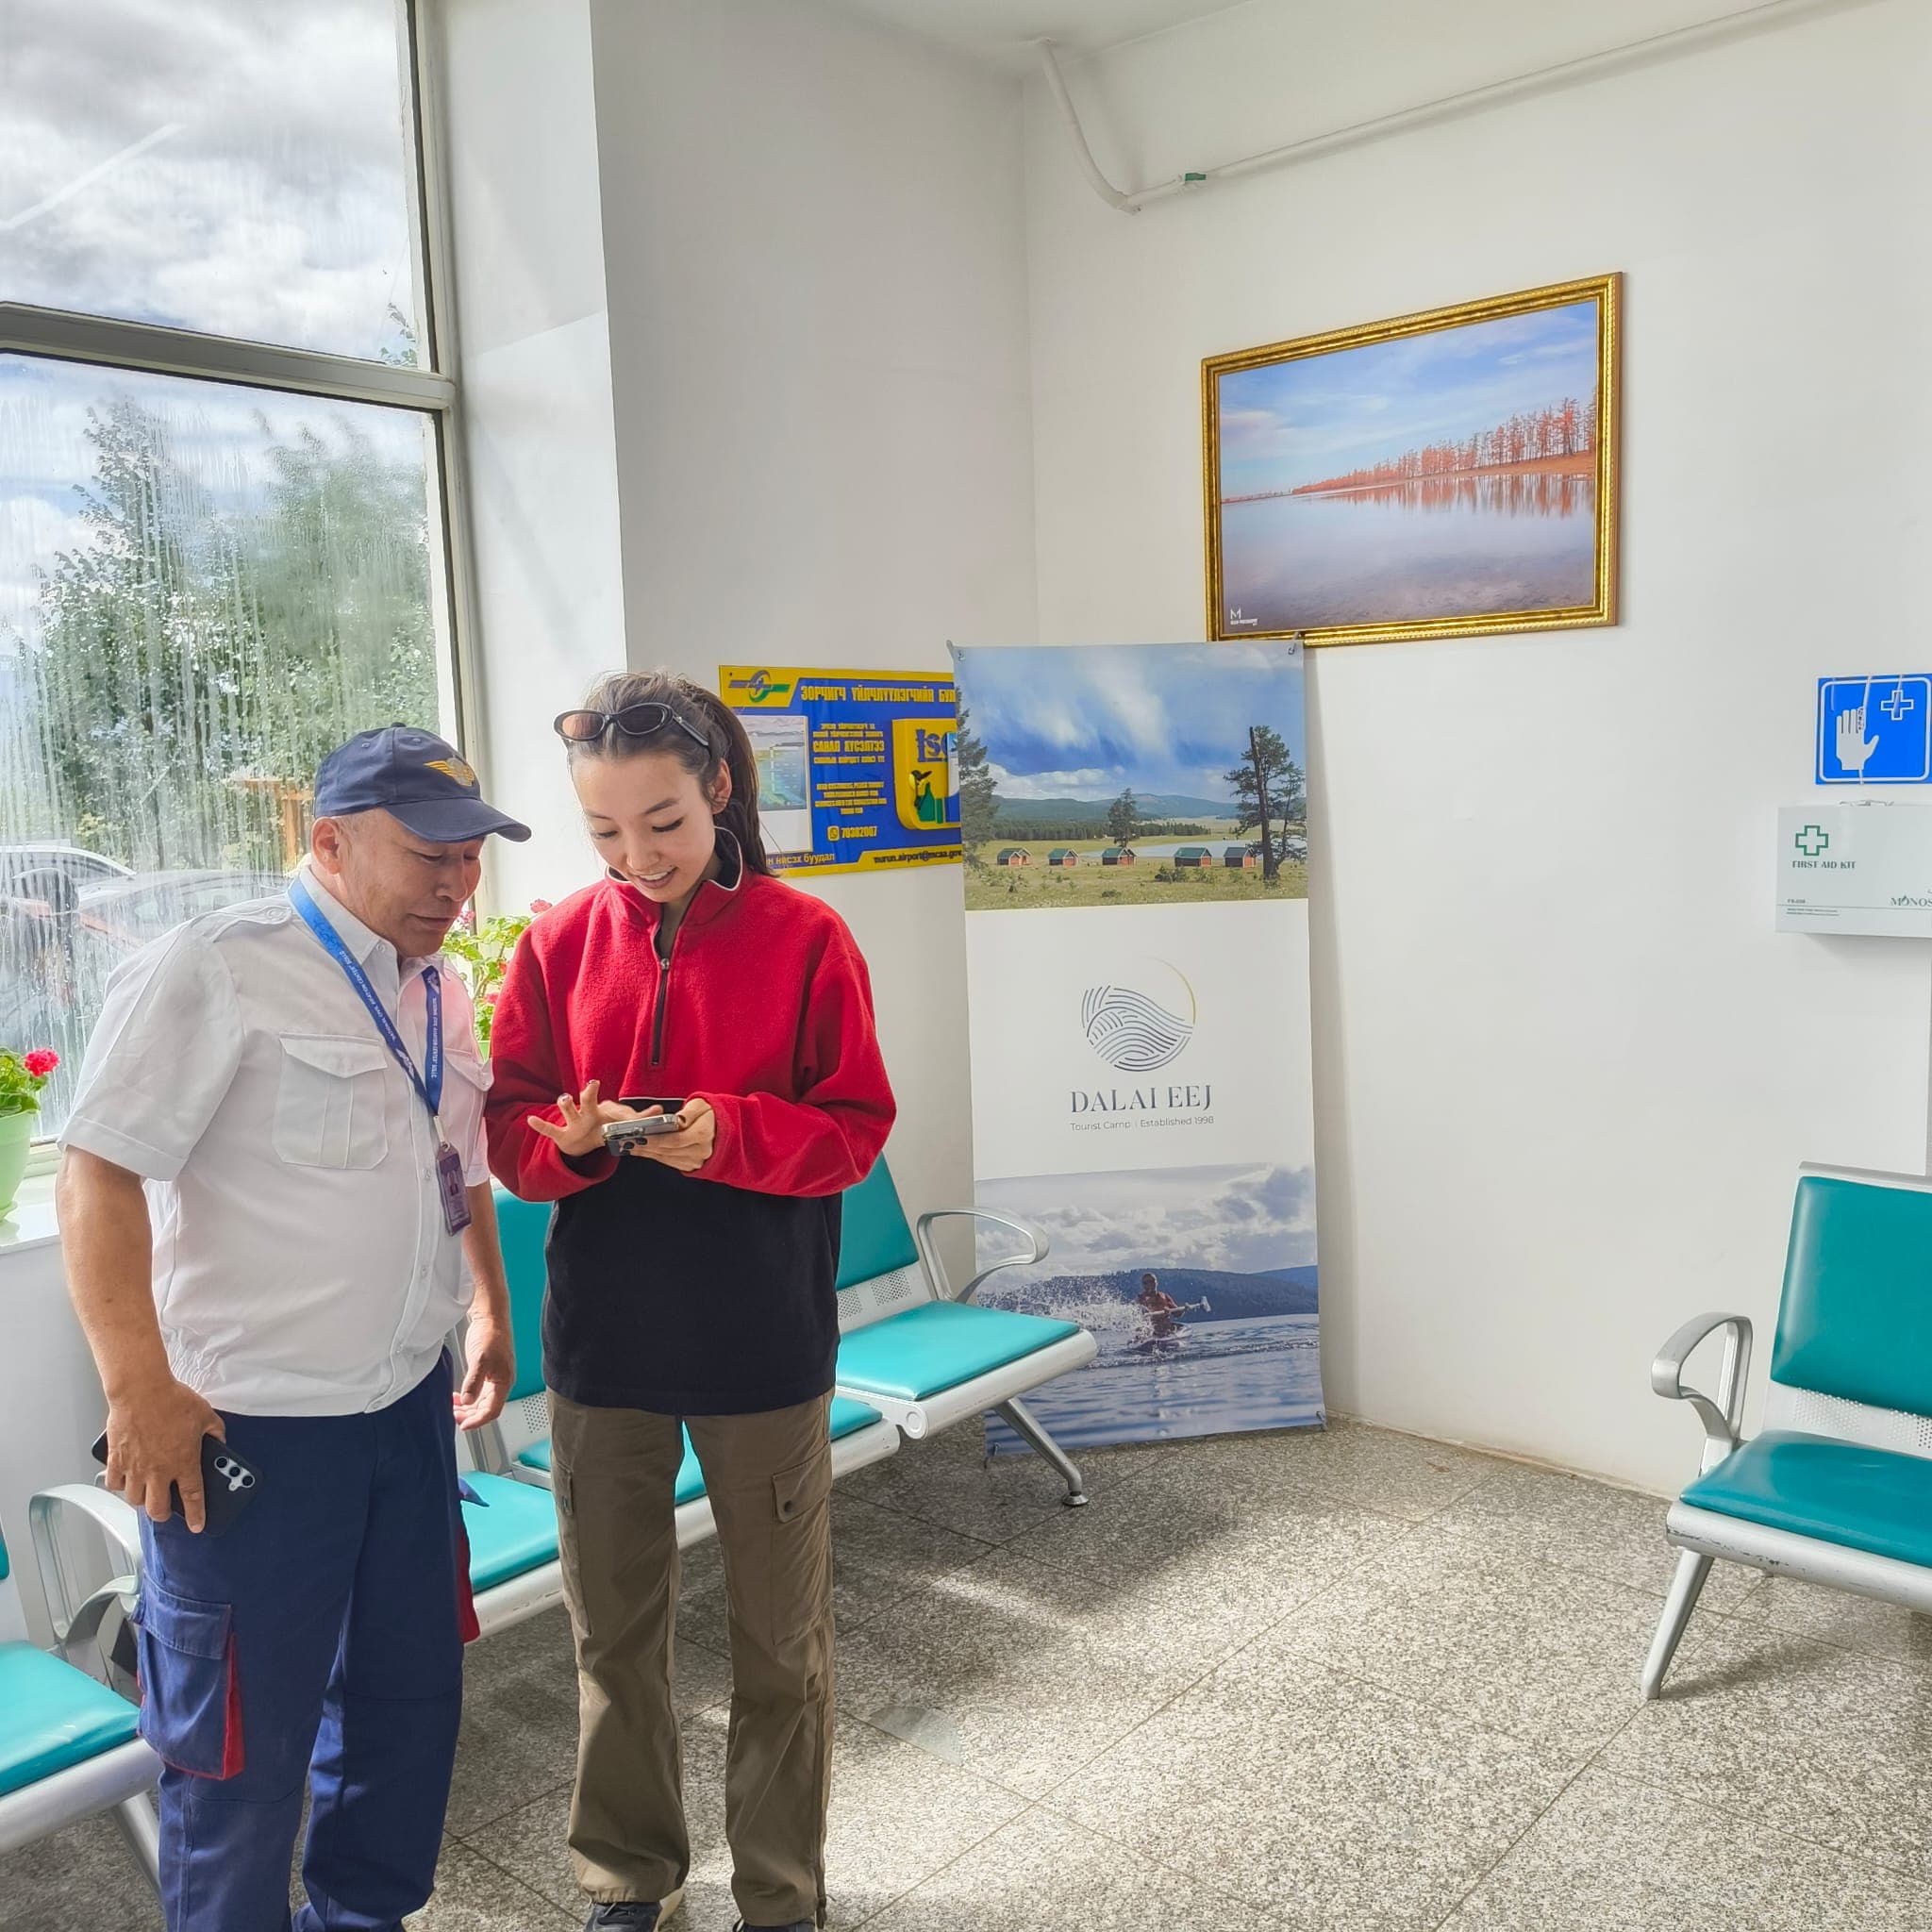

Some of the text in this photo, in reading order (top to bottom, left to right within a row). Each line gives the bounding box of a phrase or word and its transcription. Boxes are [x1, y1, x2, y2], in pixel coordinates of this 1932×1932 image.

[800, 686, 845, 701] ЗОРЧИГЧ
[1791, 860, 1857, 870] FIRST AID KIT
[1071, 1085, 1211, 1113] DALAI EEJ
[1070, 1116, 1214, 1131] Tourist Camp Established 1998
